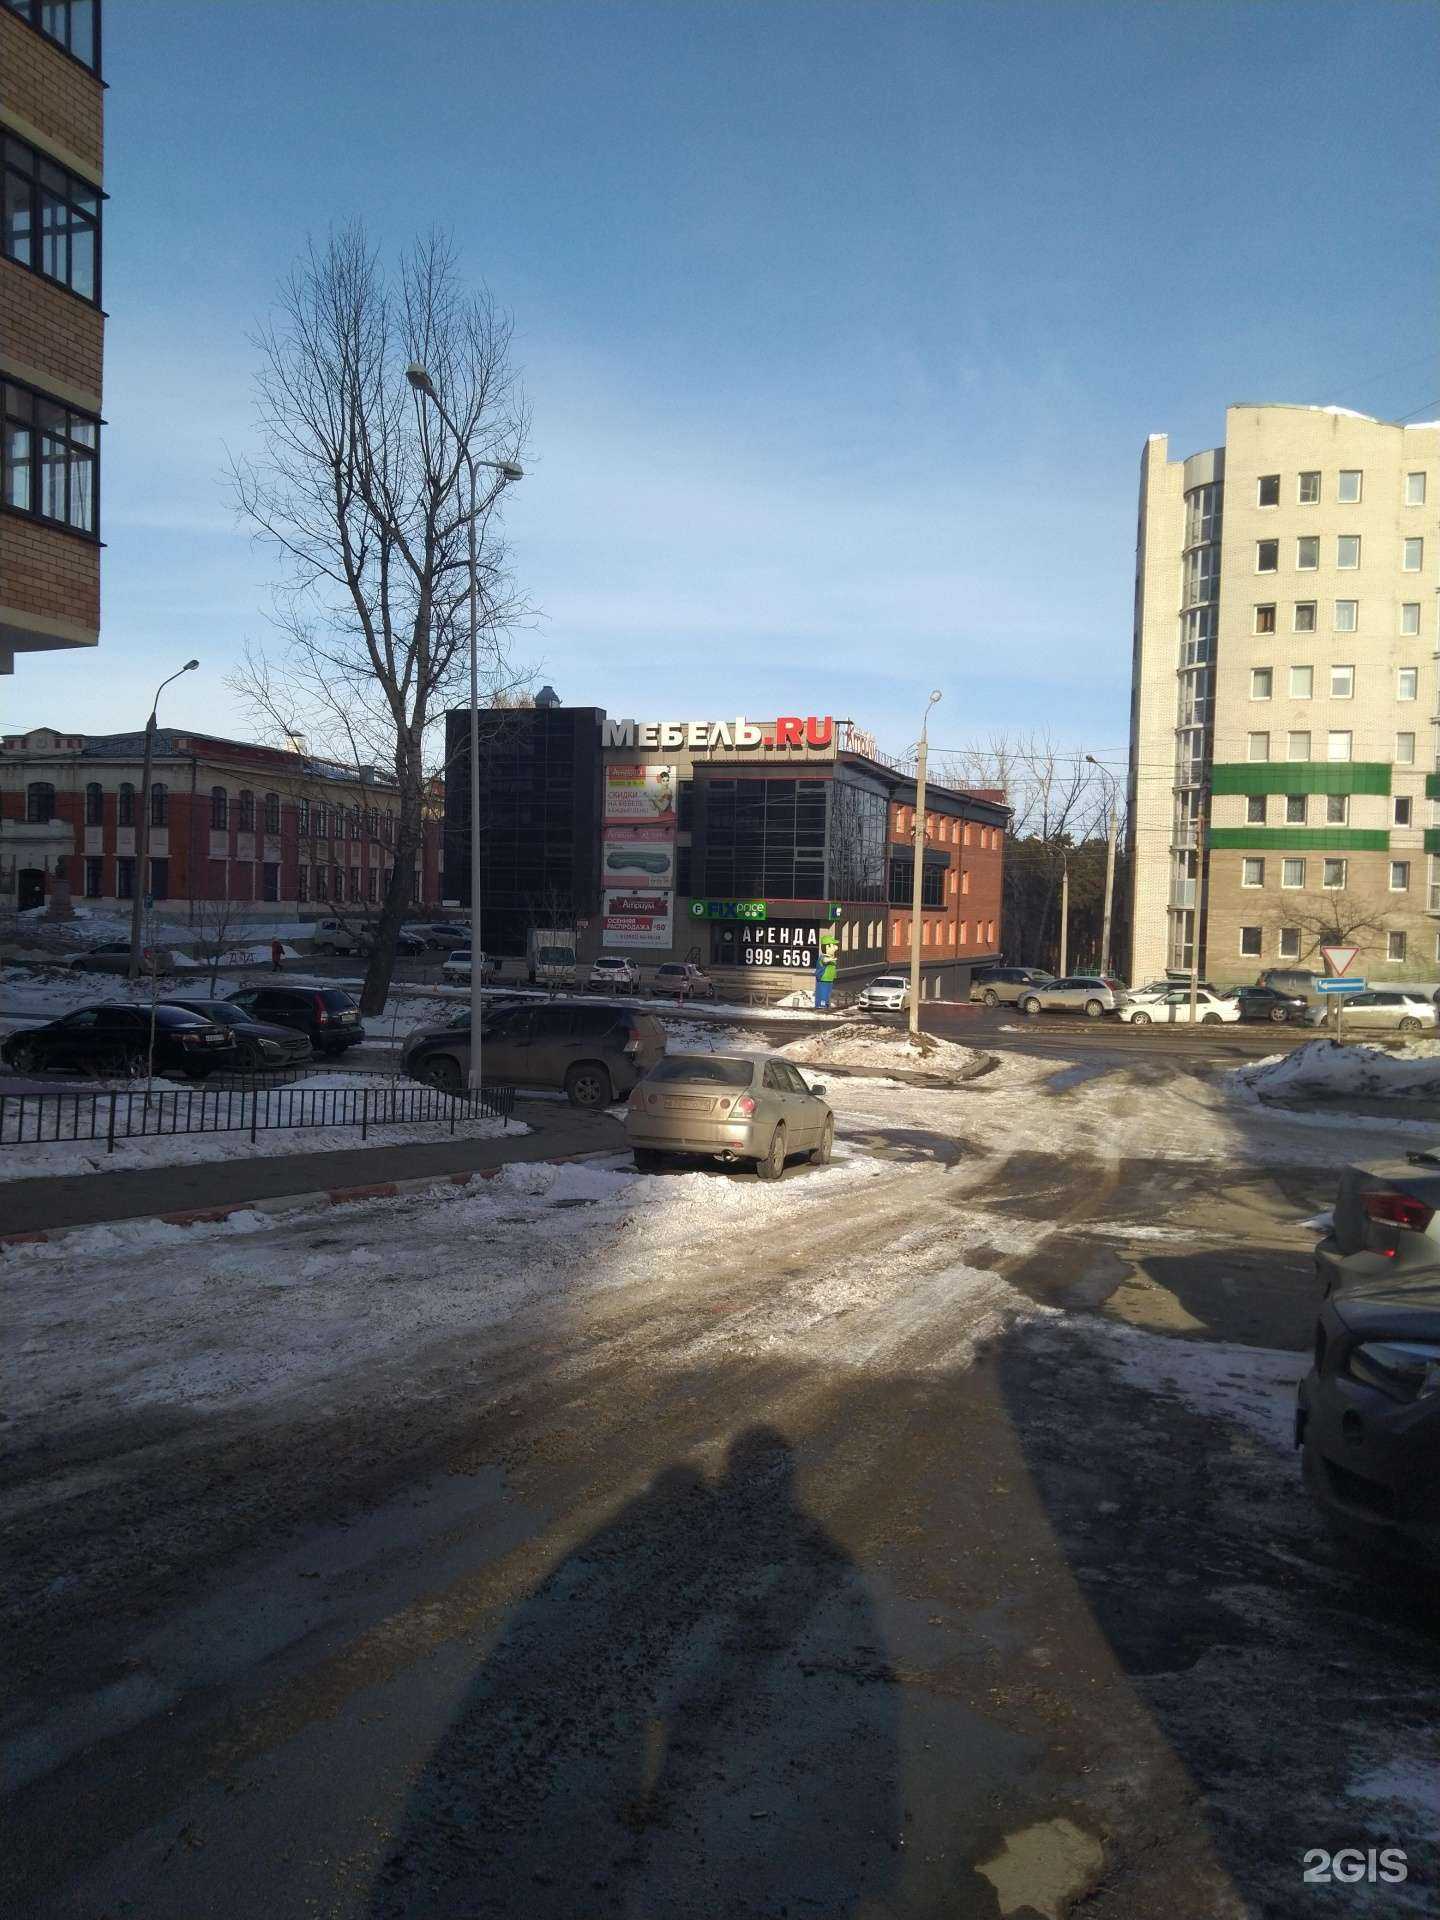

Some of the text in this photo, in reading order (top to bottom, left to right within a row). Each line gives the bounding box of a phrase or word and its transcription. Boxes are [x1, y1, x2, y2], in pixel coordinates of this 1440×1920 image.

[737, 903, 765, 914] price
[742, 926, 817, 945] АРЕНДА
[745, 948, 811, 967] 999-559
